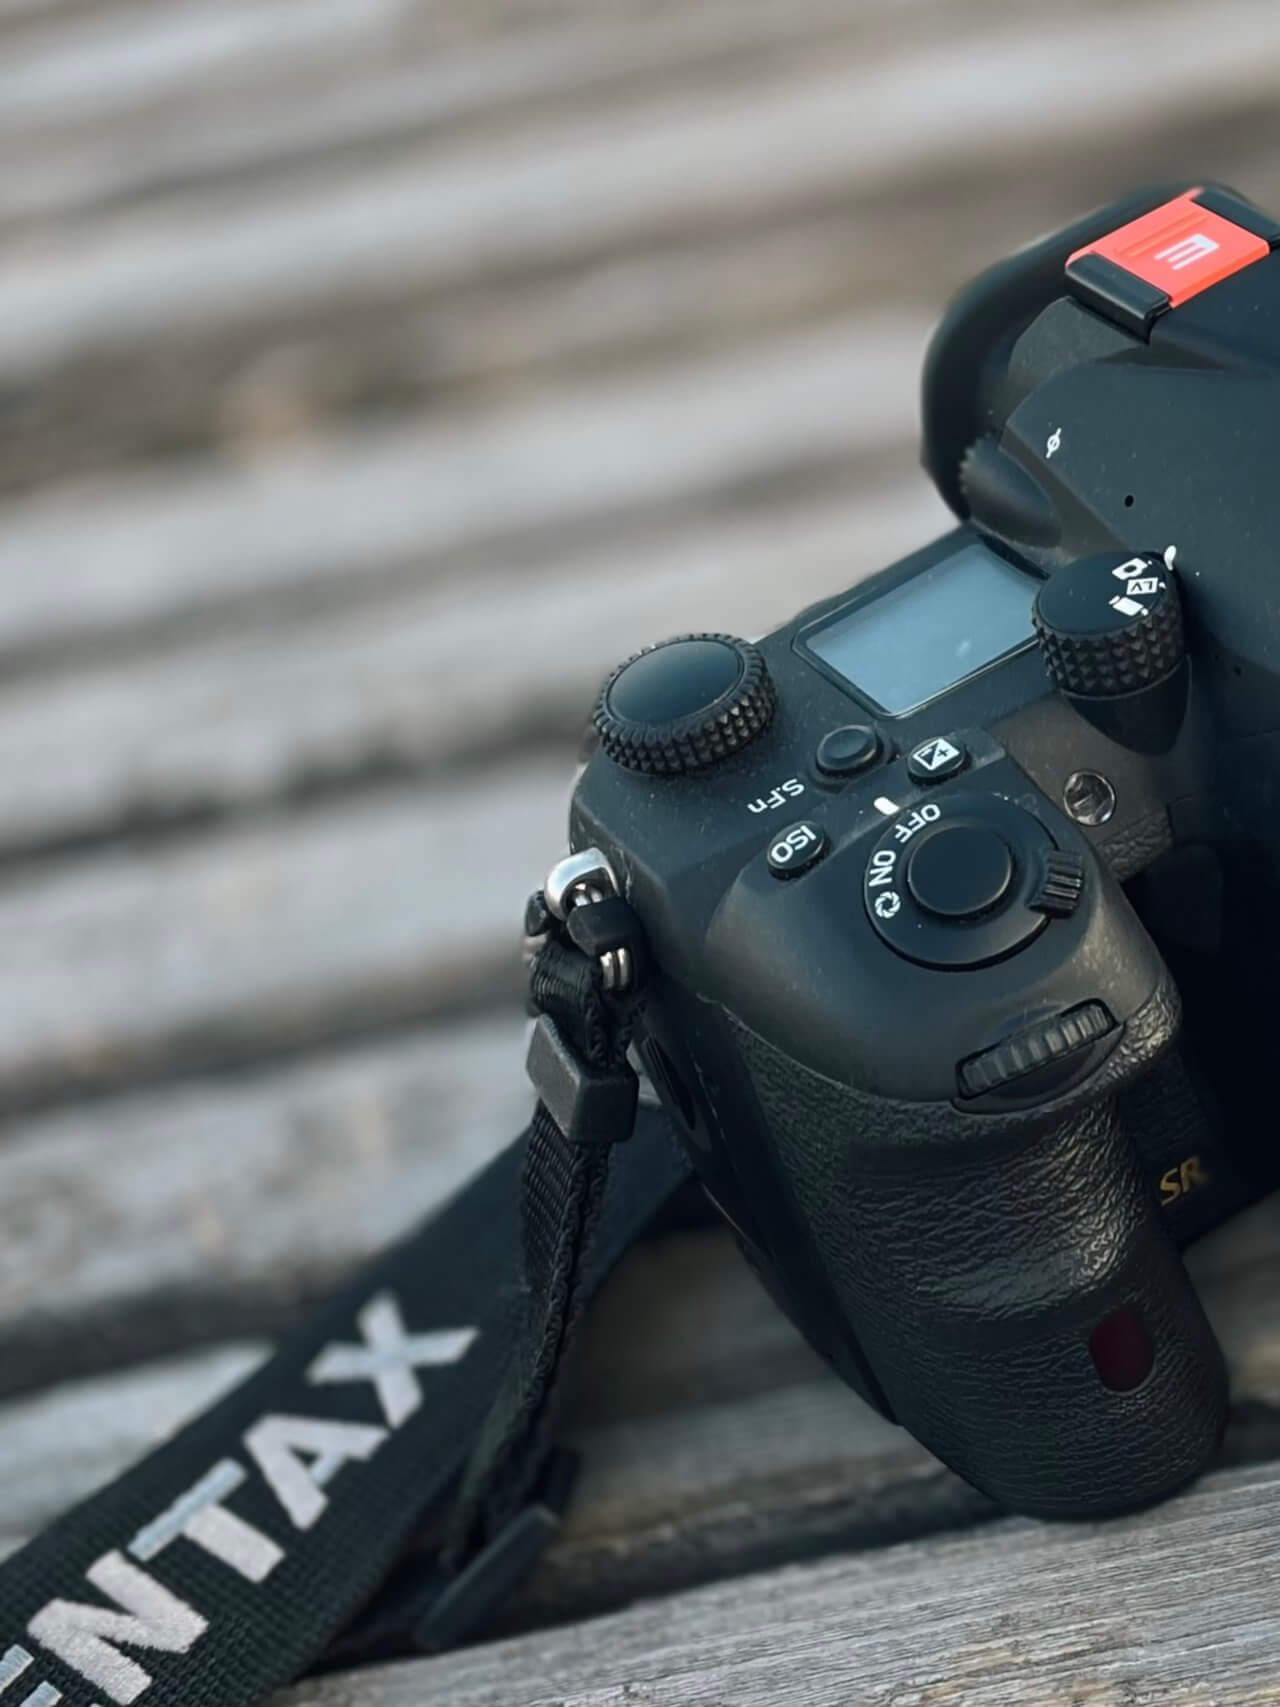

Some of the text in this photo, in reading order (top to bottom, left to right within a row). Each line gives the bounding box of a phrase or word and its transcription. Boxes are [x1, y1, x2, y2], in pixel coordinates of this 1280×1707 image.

[747, 778, 805, 814] S.Fn
[894, 803, 942, 844] OFF
[770, 825, 817, 863] ISO
[868, 850, 897, 887] ON
[1160, 1155, 1210, 1207] SR
